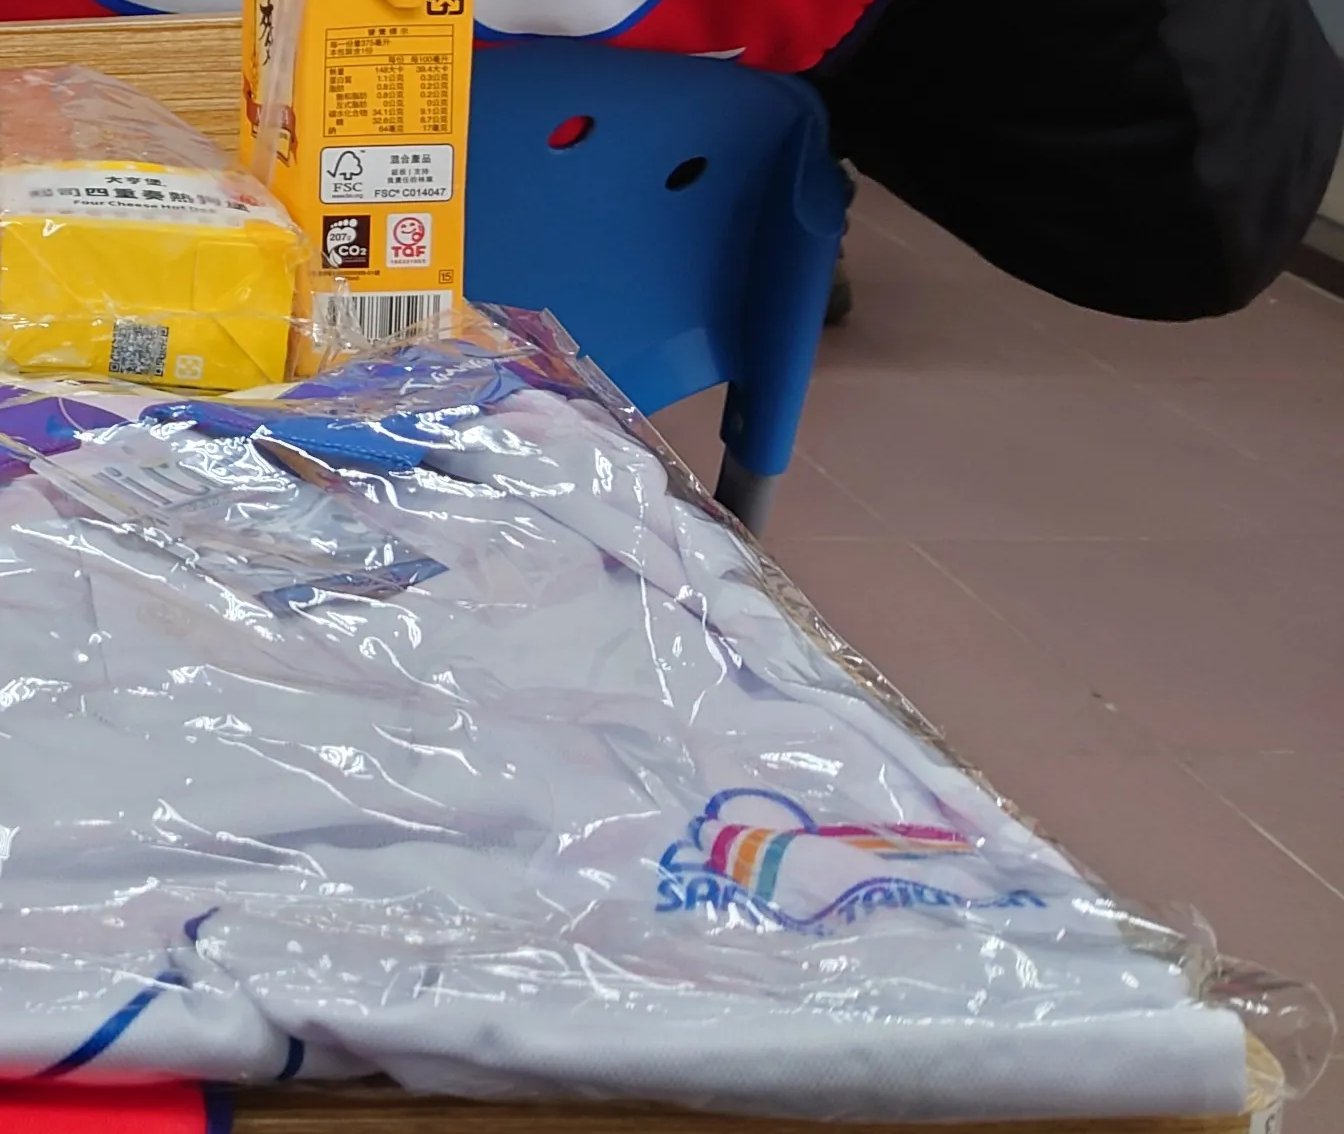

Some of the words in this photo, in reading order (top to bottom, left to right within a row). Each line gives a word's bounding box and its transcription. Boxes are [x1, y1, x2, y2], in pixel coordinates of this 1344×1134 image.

[390, 154, 432, 164] 混合產品
[332, 182, 363, 193] FSC
[402, 187, 446, 198] C014047
[73, 199, 105, 207] Four
[108, 200, 158, 209] Cheese
[391, 246, 426, 257] TQF
[441, 273, 451, 282] 15
